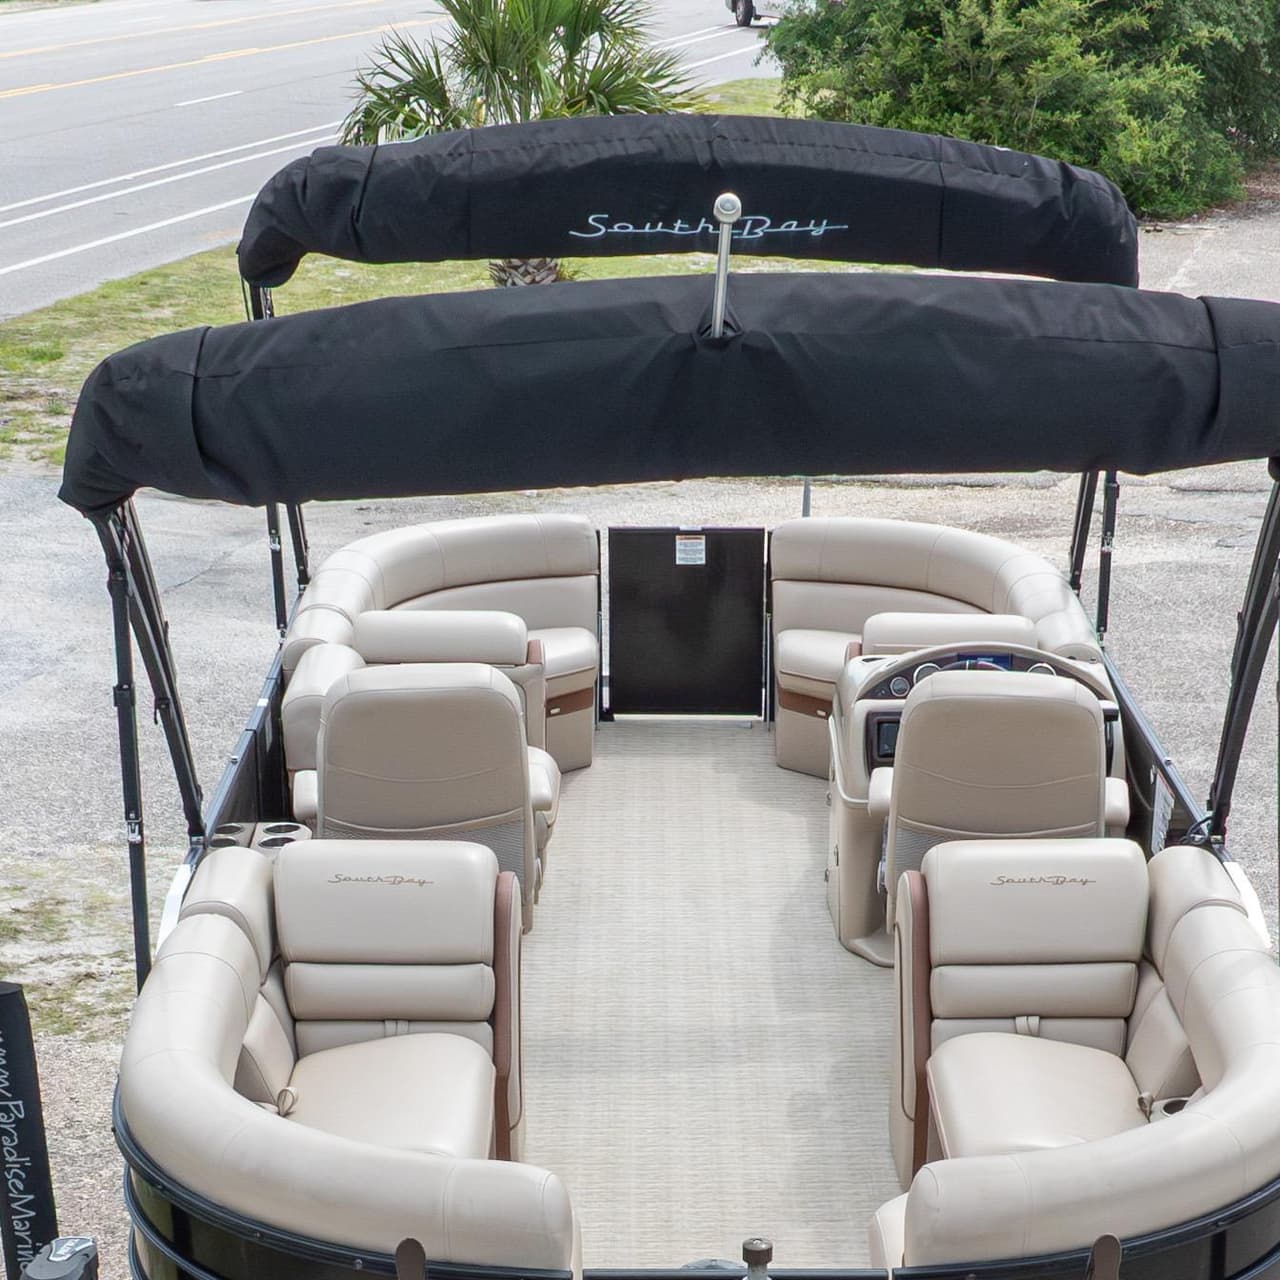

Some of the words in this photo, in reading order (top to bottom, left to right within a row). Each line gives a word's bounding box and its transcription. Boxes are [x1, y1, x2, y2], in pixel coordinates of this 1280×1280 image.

[570, 215, 720, 237] South
[731, 216, 848, 238] Bay
[990, 876, 1047, 886] South
[1047, 876, 1096, 886] Bay
